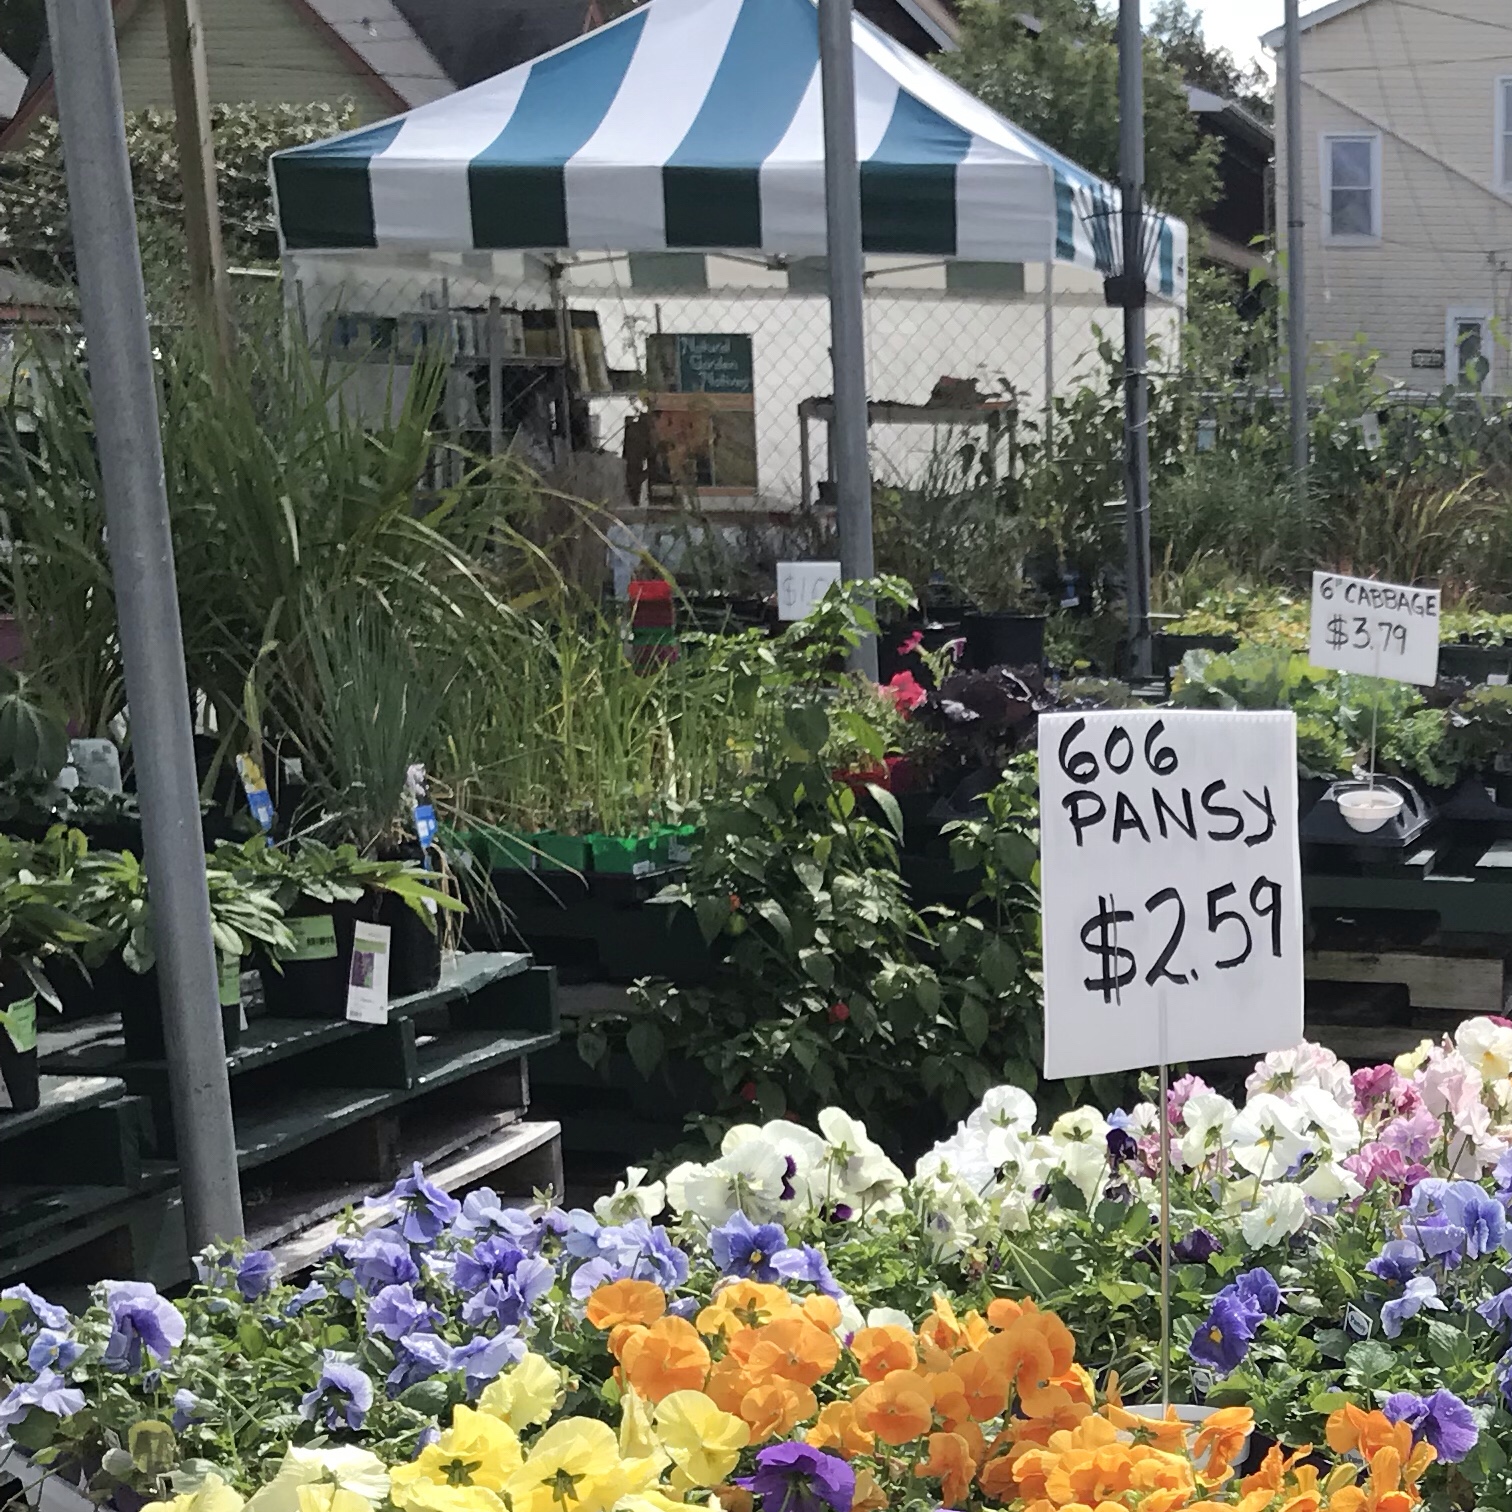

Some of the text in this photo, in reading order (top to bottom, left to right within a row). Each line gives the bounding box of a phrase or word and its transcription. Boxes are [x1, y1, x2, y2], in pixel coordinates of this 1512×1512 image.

[1344, 583, 1437, 617] CABBAGE
[1325, 613, 1407, 655] $3.79
[1058, 717, 1178, 784] 606
[1080, 875, 1282, 1006] $2.59
